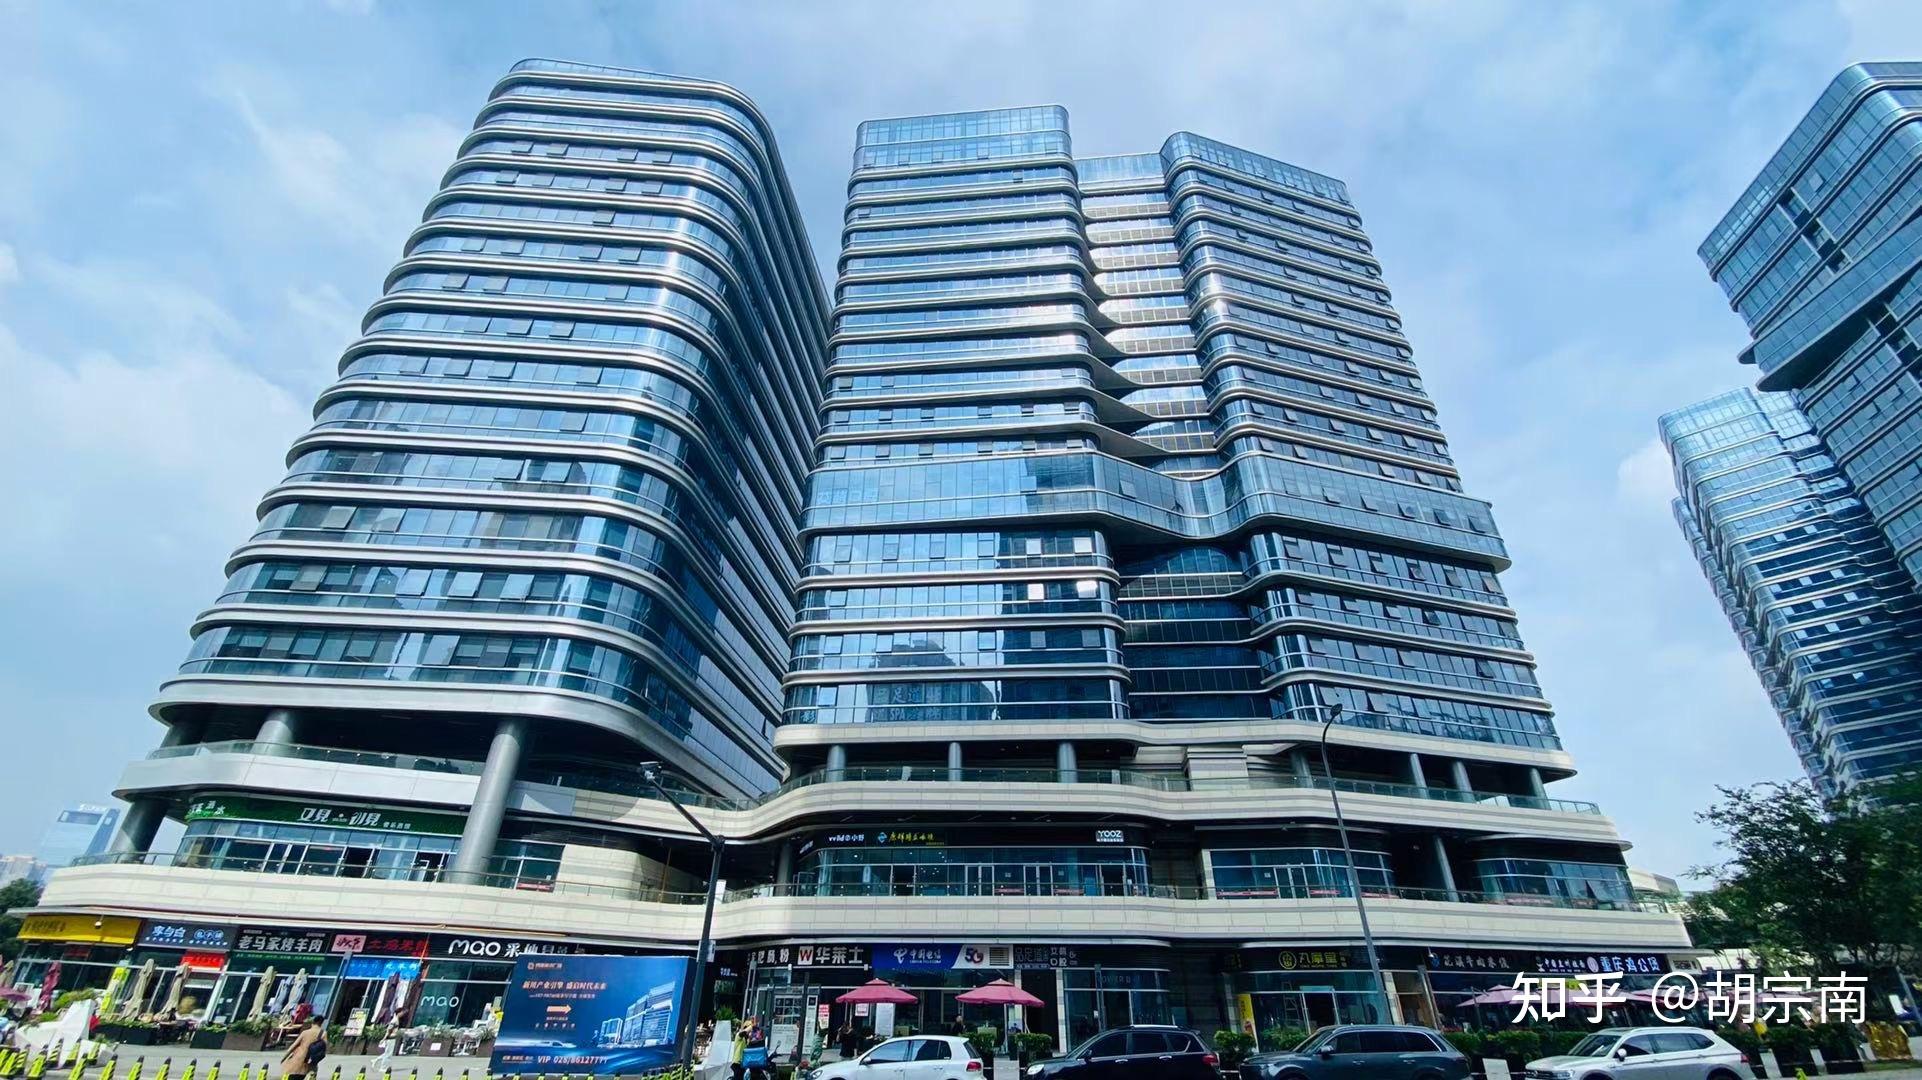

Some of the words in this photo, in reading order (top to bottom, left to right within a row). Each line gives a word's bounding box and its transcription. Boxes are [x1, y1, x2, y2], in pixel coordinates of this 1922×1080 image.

[1097, 830, 1122, 838] YOOZ
[239, 935, 323, 953] 老马家烤羊肉
[816, 946, 864, 964] 华莱士
[909, 948, 942, 959] 中国电信
[964, 947, 984, 963] 5G
[537, 1055, 551, 1064] VIP
